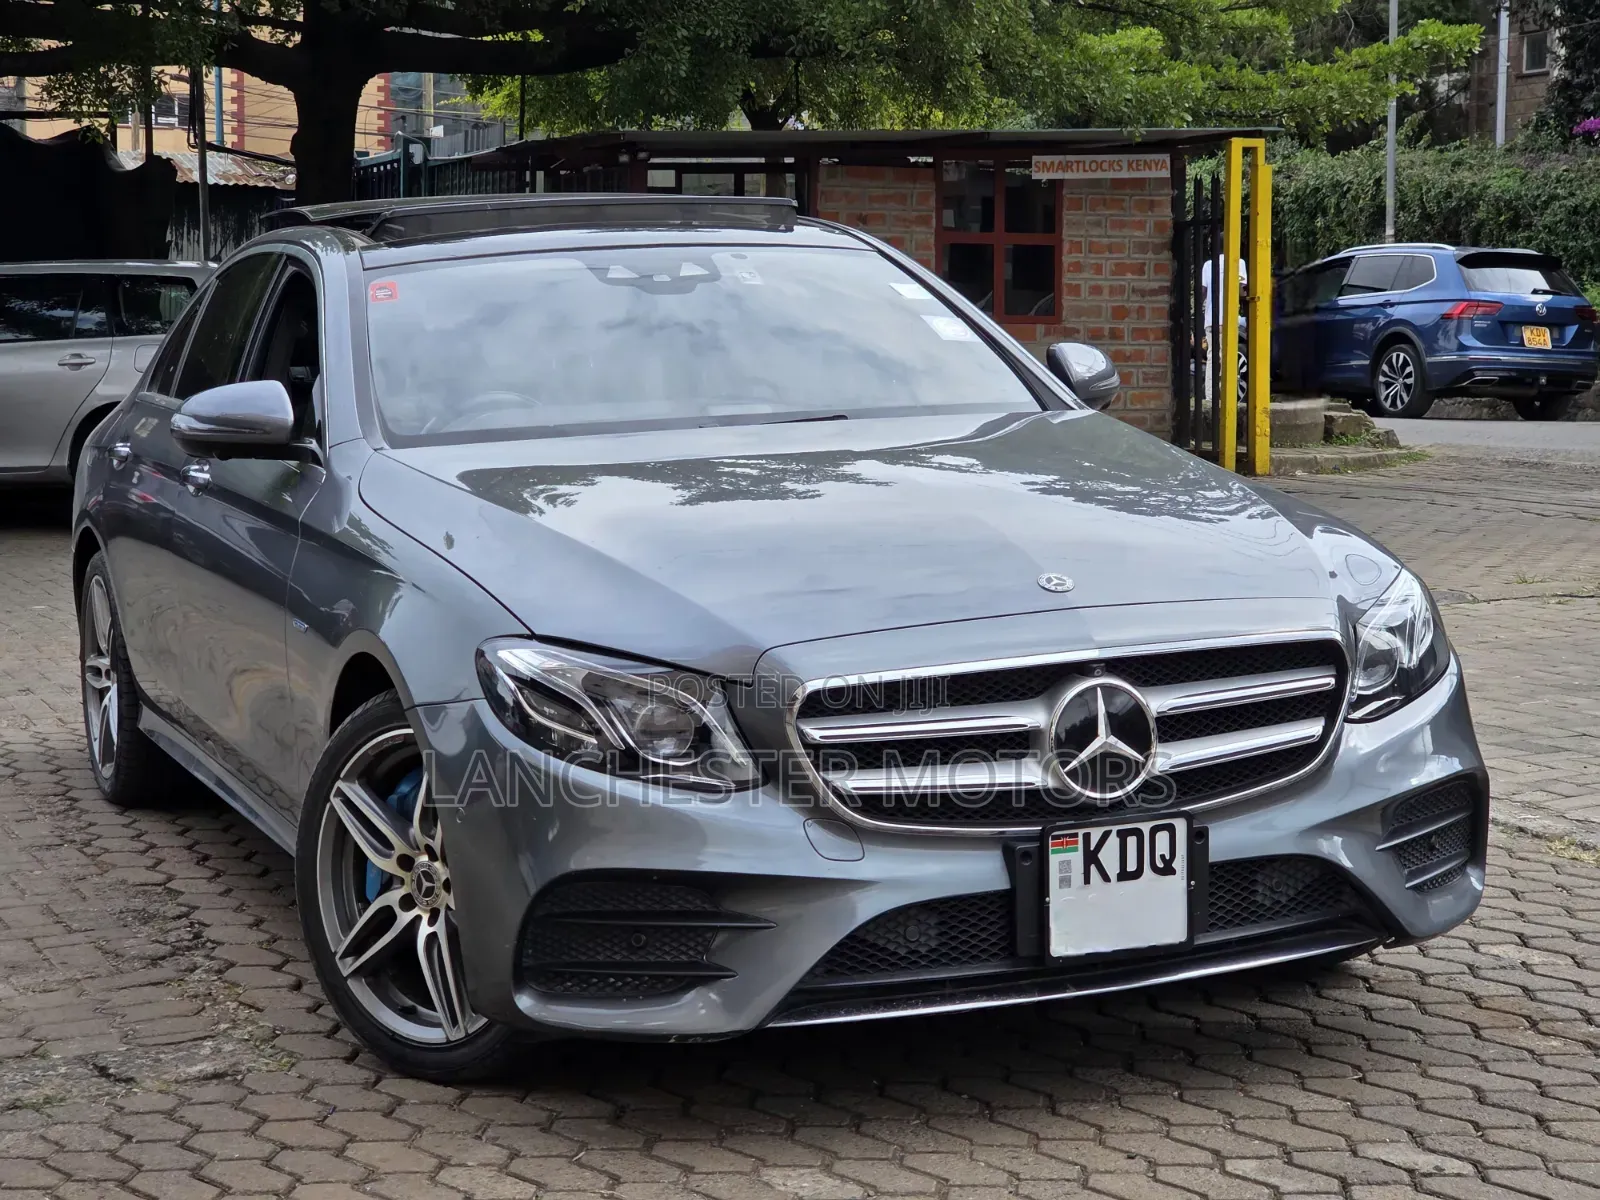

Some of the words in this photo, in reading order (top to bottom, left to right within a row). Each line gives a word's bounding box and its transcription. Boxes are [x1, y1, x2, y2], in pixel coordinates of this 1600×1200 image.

[1034, 160, 1123, 173] SMARTLOCKS
[1127, 159, 1168, 172] KENYA
[1530, 327, 1546, 337] KDV
[1082, 822, 1176, 885] KDQ
